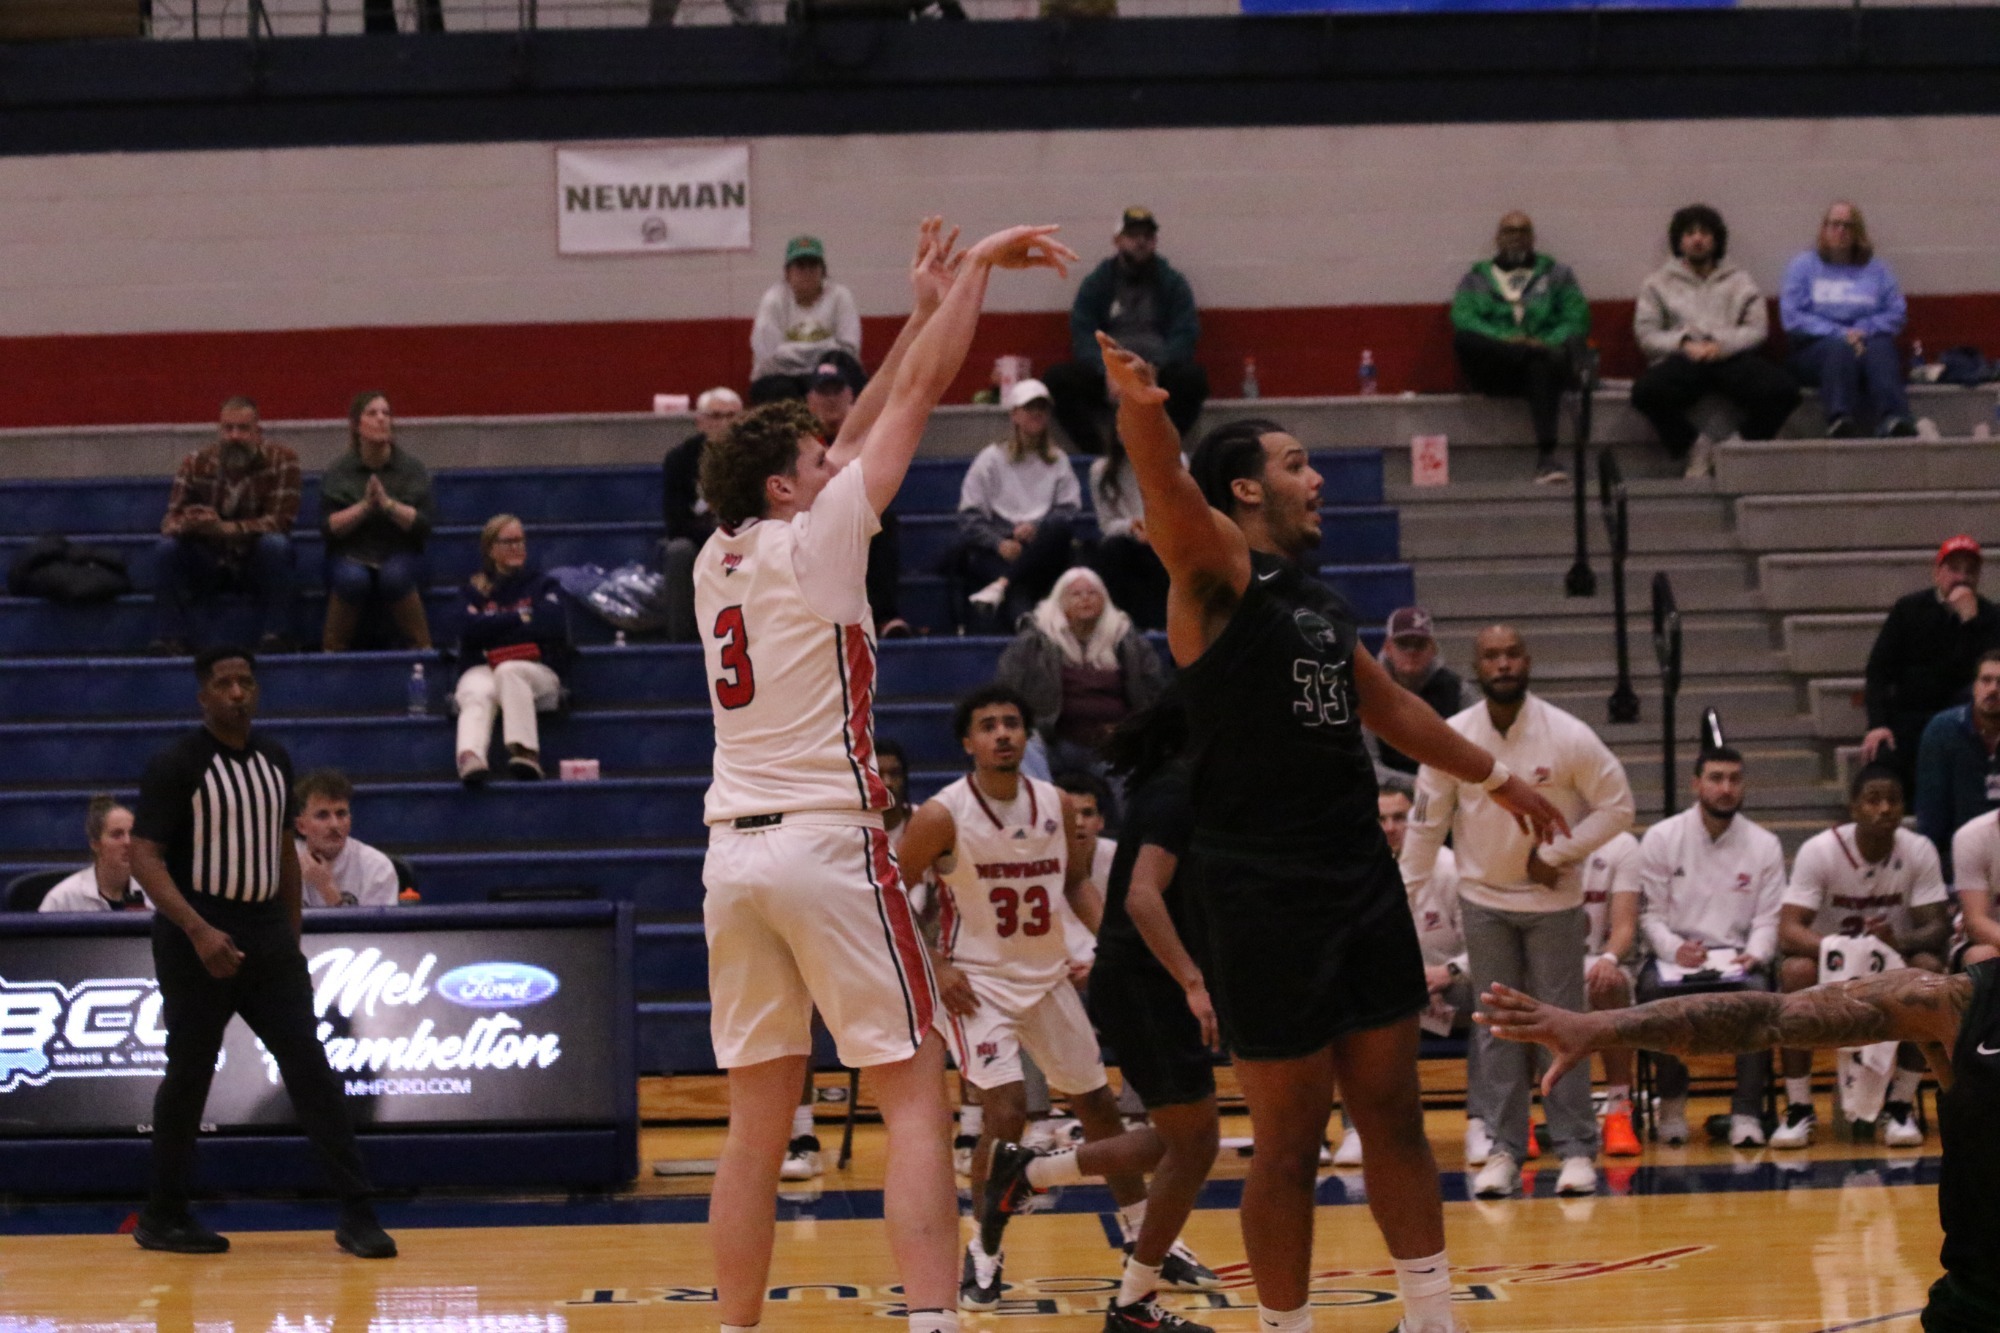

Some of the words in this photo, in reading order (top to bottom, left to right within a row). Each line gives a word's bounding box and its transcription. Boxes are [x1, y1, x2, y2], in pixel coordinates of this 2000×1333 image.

[565, 181, 746, 211] NEWMAN
[714, 604, 756, 711] 3
[1293, 659, 1349, 726] 33
[975, 858, 1061, 880] NEWMAN
[989, 885, 1051, 938] 33
[308, 947, 437, 1018] Mel
[459, 973, 534, 1000] Ford
[258, 1012, 561, 1080] ambelton
[345, 1079, 471, 1096] MHFORD.COM
